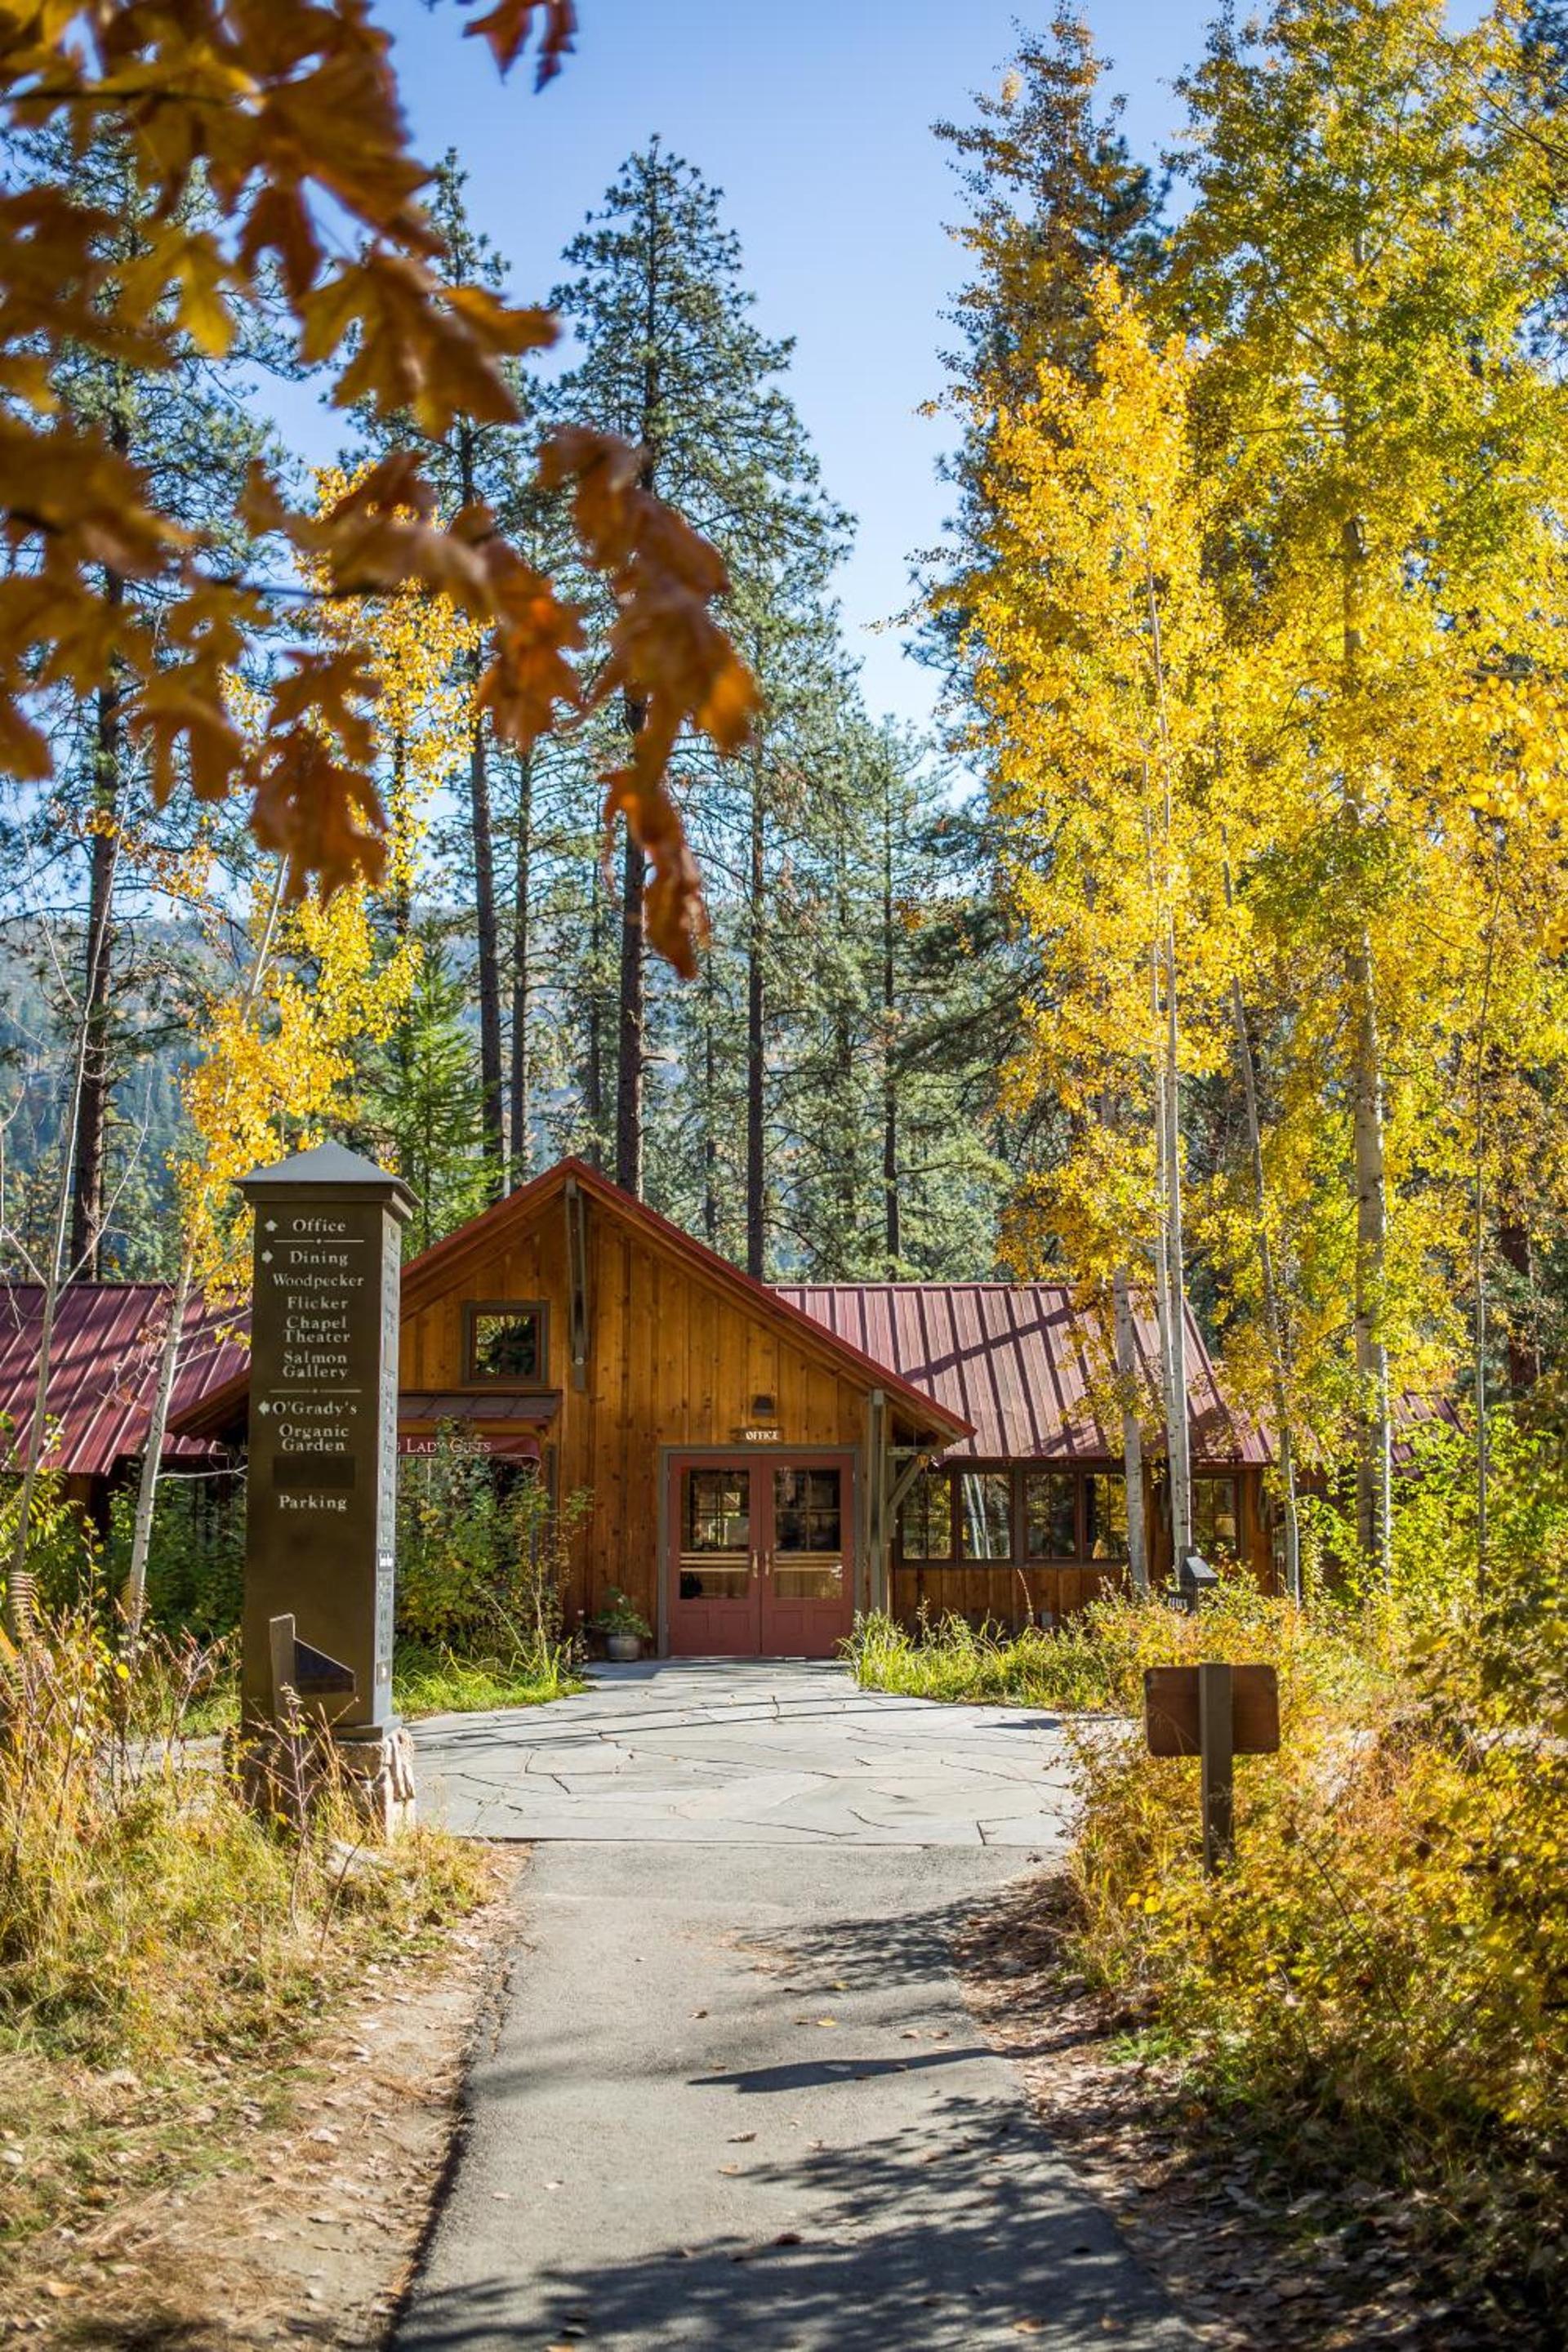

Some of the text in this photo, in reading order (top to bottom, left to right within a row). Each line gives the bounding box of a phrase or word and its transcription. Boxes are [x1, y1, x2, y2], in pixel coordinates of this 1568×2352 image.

[292, 1218, 346, 1232] Office
[290, 1250, 349, 1266] Dining
[273, 1274, 364, 1288] Woodpecker
[287, 1296, 349, 1310] Flicker
[286, 1316, 346, 1331] Chapel
[284, 1330, 350, 1343] Theater
[284, 1351, 347, 1365] Salmon
[283, 1365, 349, 1379] Gallery
[273, 1401, 357, 1416] O'Grady's
[278, 1423, 349, 1439] Organic
[746, 1431, 778, 1441] OFFICE
[282, 1438, 345, 1451] Garden
[279, 1494, 347, 1511] Parking
